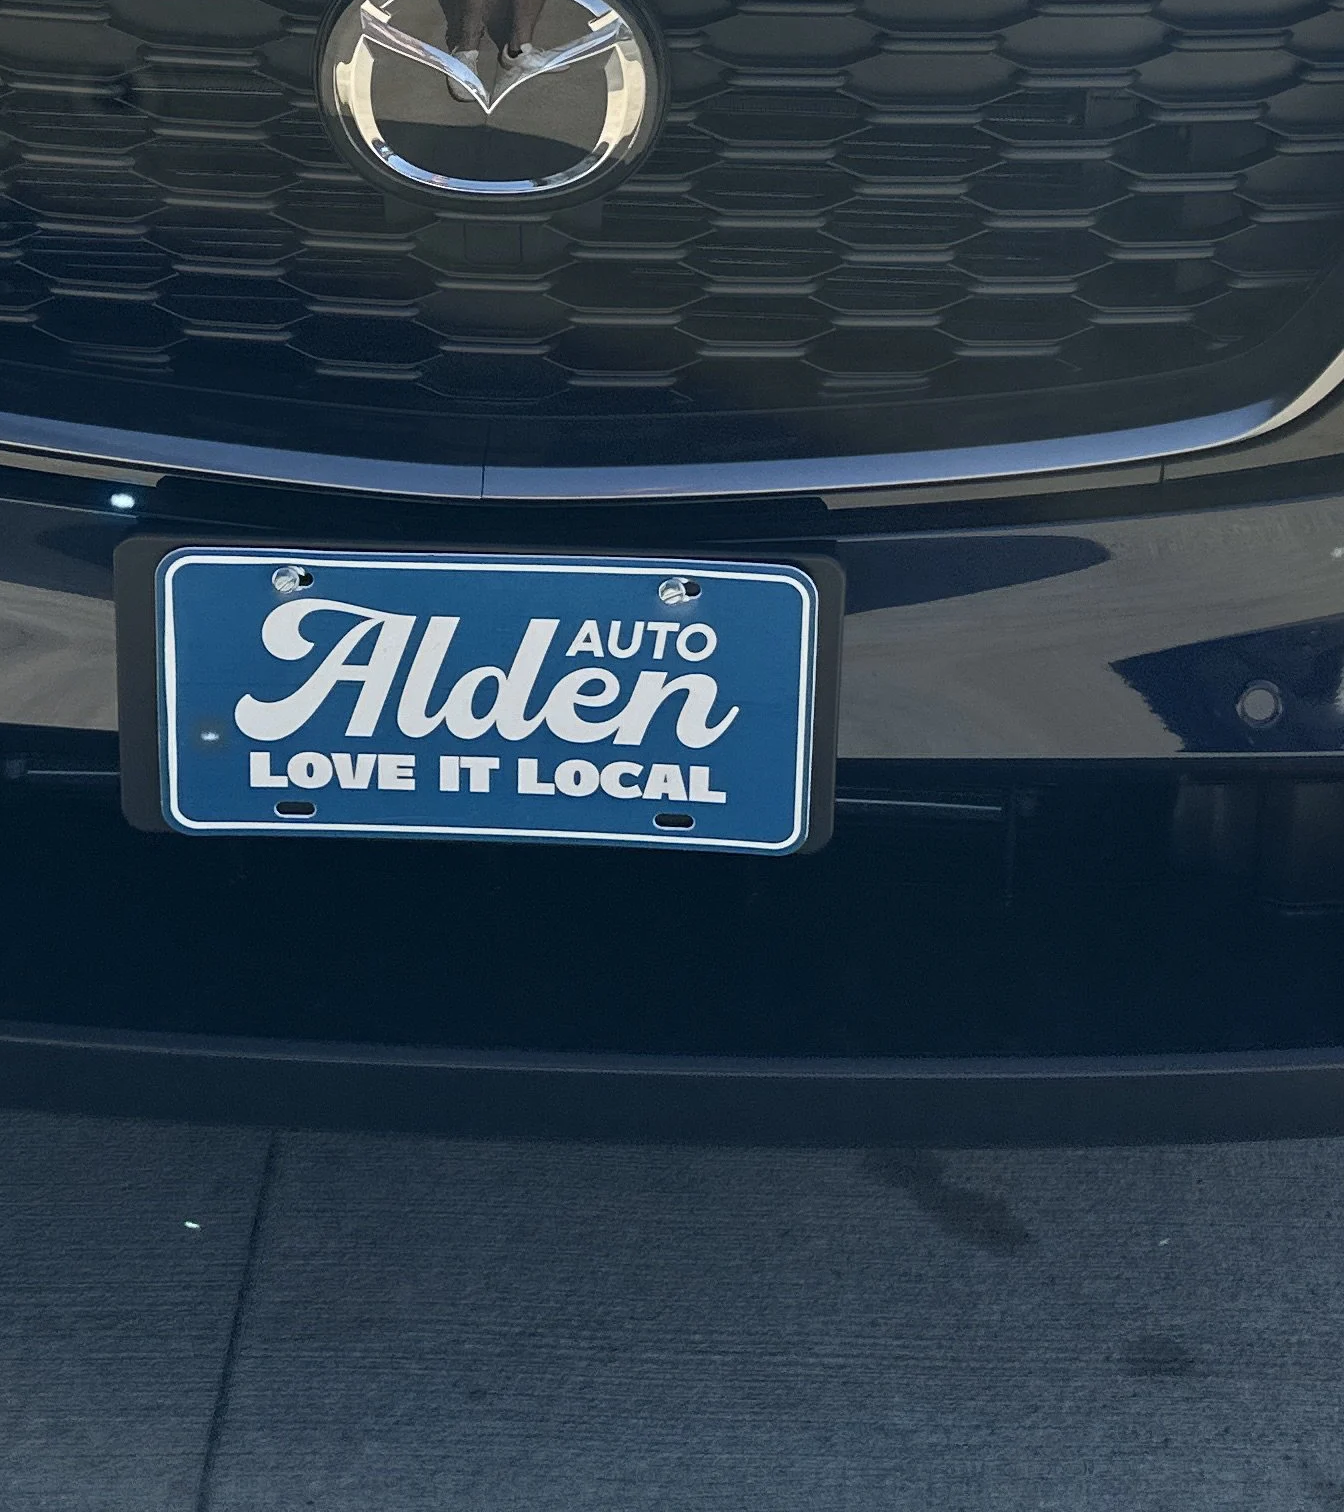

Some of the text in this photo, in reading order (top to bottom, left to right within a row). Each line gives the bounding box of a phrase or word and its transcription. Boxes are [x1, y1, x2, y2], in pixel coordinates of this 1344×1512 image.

[566, 620, 717, 661] AUTO
[235, 599, 739, 748] Alden
[249, 751, 727, 804] LOVE IT LOCAL
